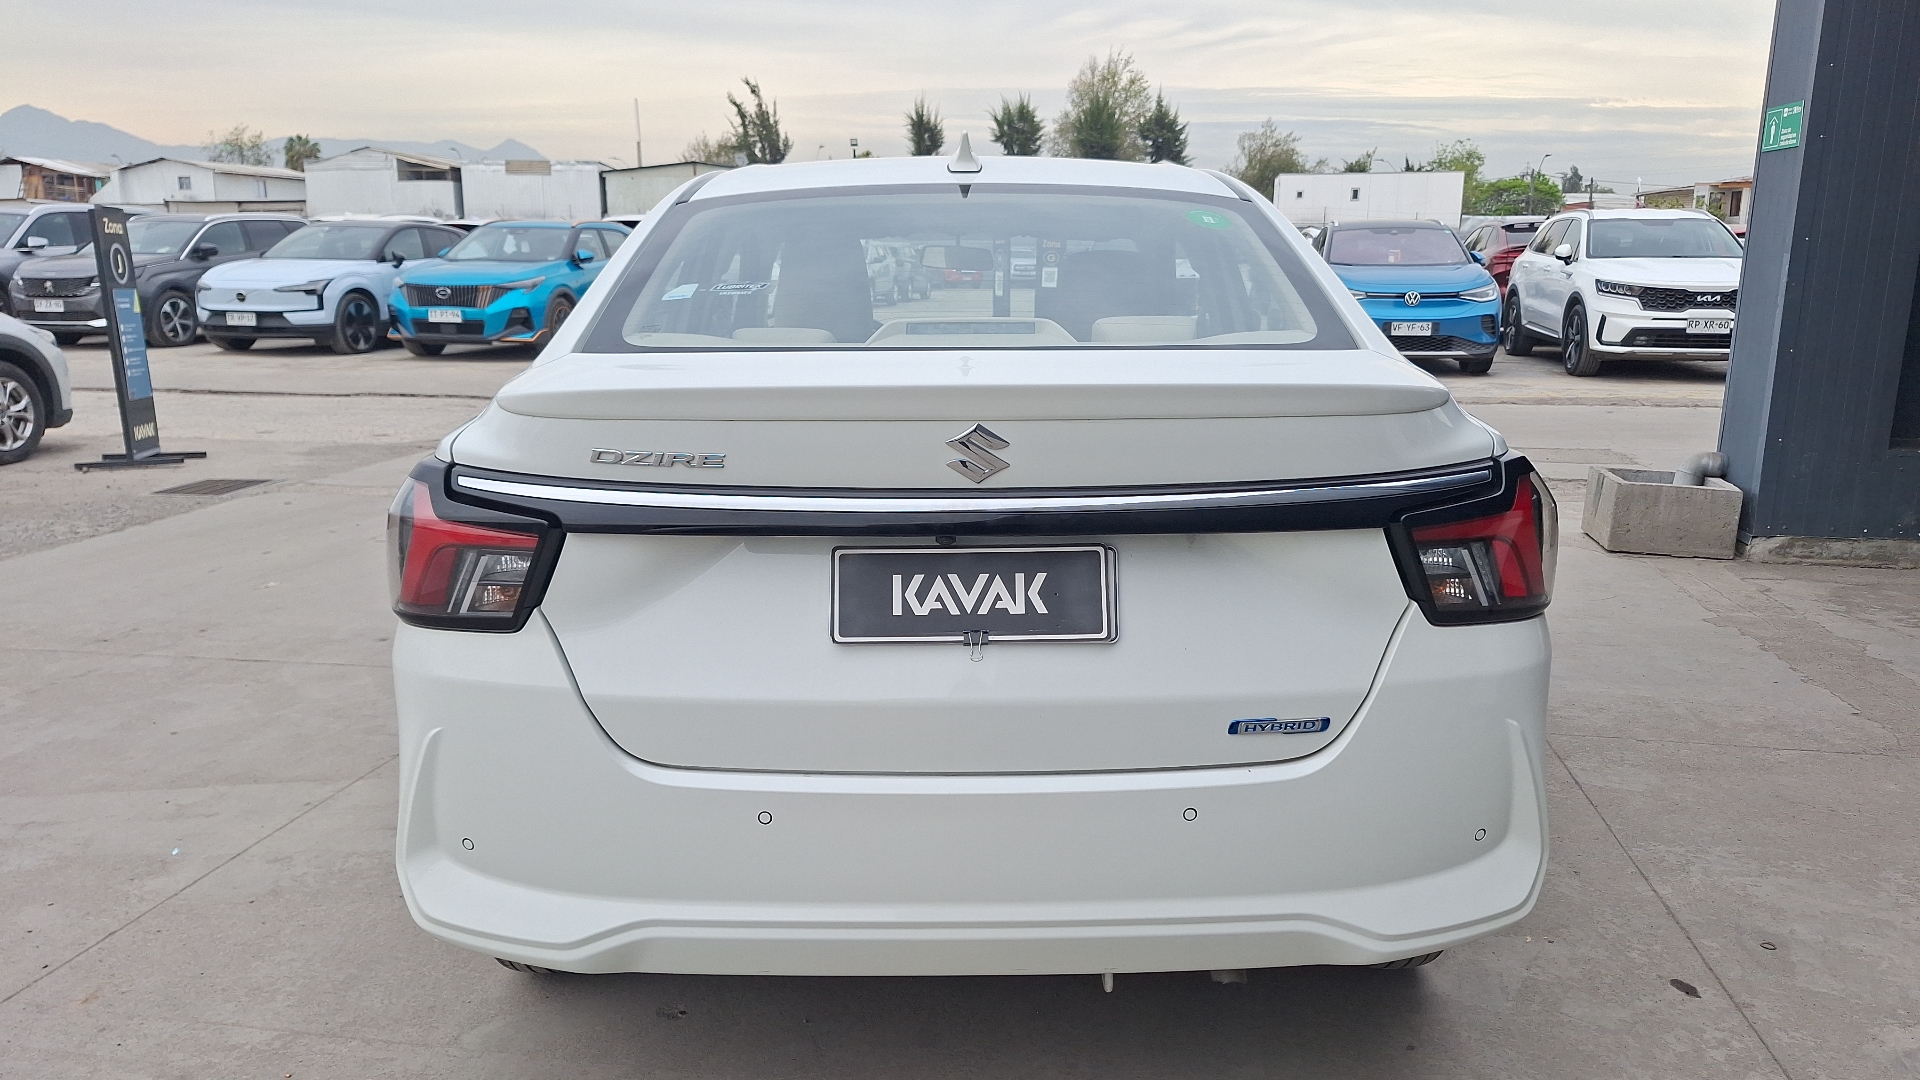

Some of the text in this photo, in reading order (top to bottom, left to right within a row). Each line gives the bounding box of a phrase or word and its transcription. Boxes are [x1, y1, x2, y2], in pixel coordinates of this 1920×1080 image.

[103, 217, 123, 234] Zona
[590, 448, 726, 468] DZIRE
[892, 572, 1049, 616] KAVAK
[1244, 721, 1316, 732] HYBRID
